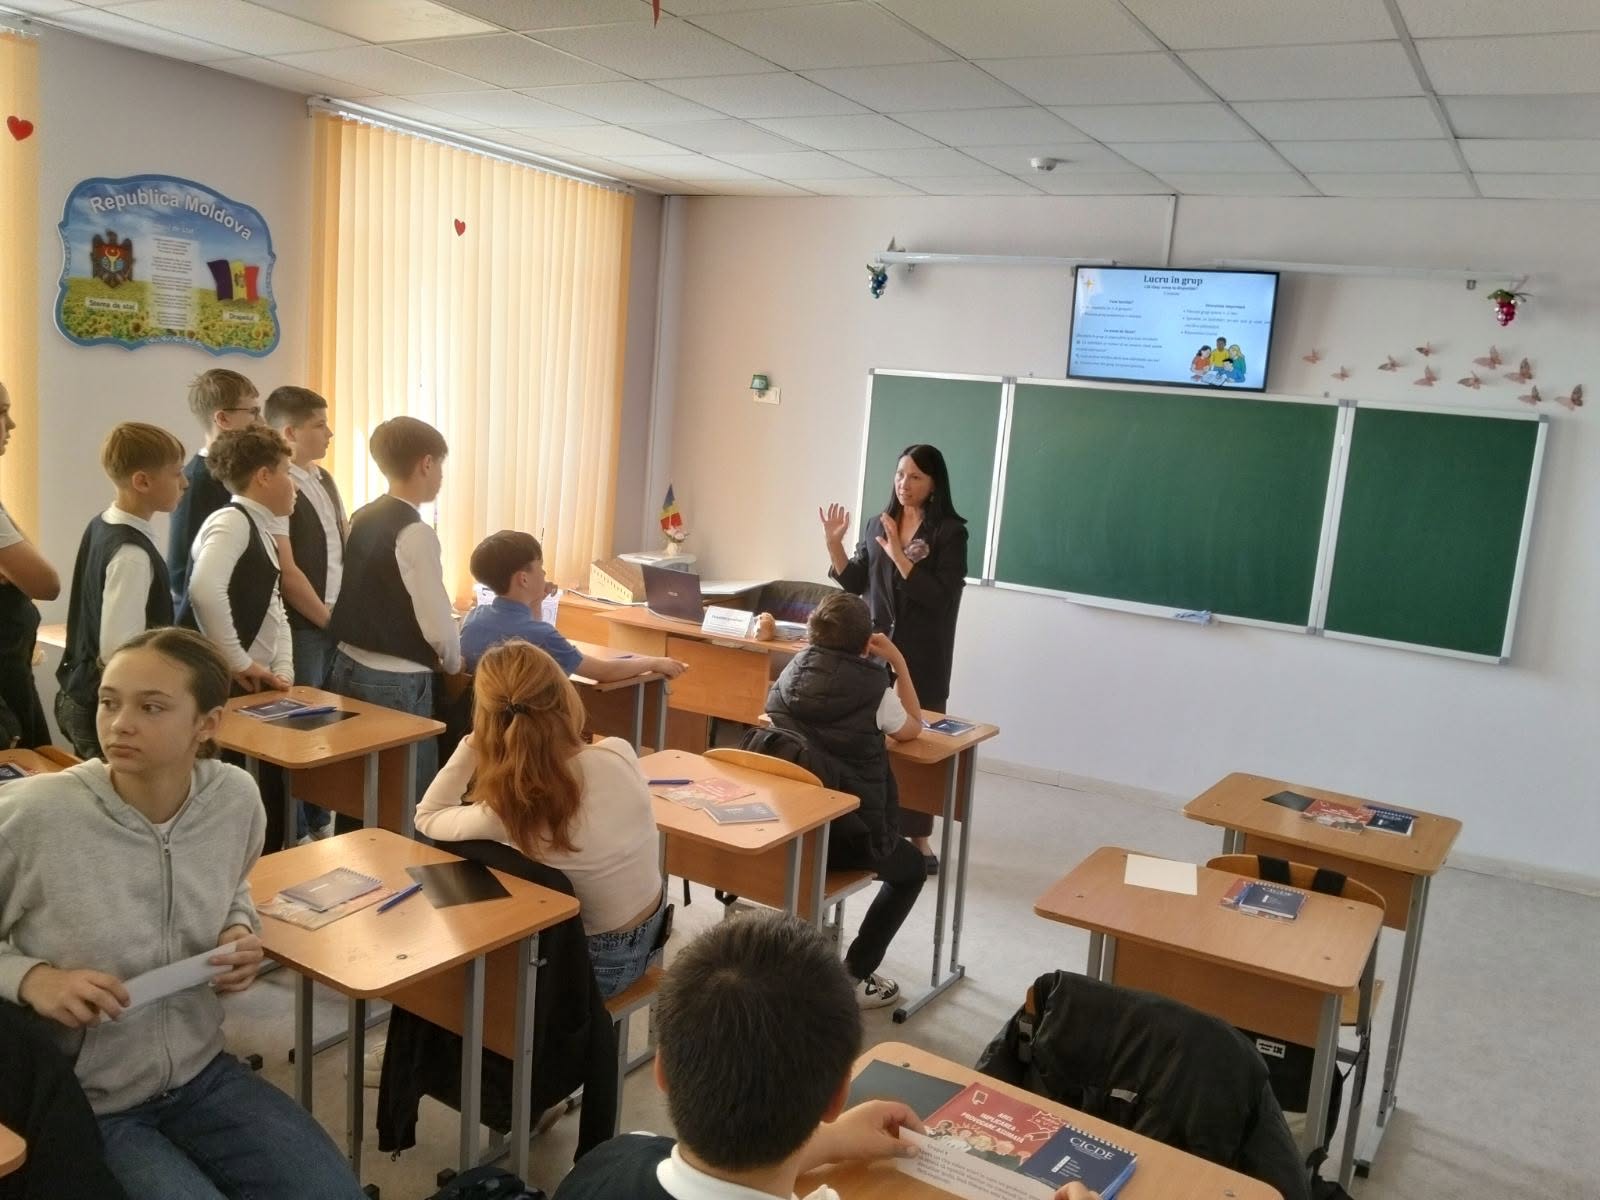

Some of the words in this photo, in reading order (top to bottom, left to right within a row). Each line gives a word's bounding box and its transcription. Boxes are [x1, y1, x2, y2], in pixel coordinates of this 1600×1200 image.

[89, 188, 179, 214] Republica
[184, 195, 252, 241] Moldova
[1143, 275, 1169, 283] Lucru
[1181, 277, 1203, 287] grup
[1070, 1137, 1116, 1160] CICDE
